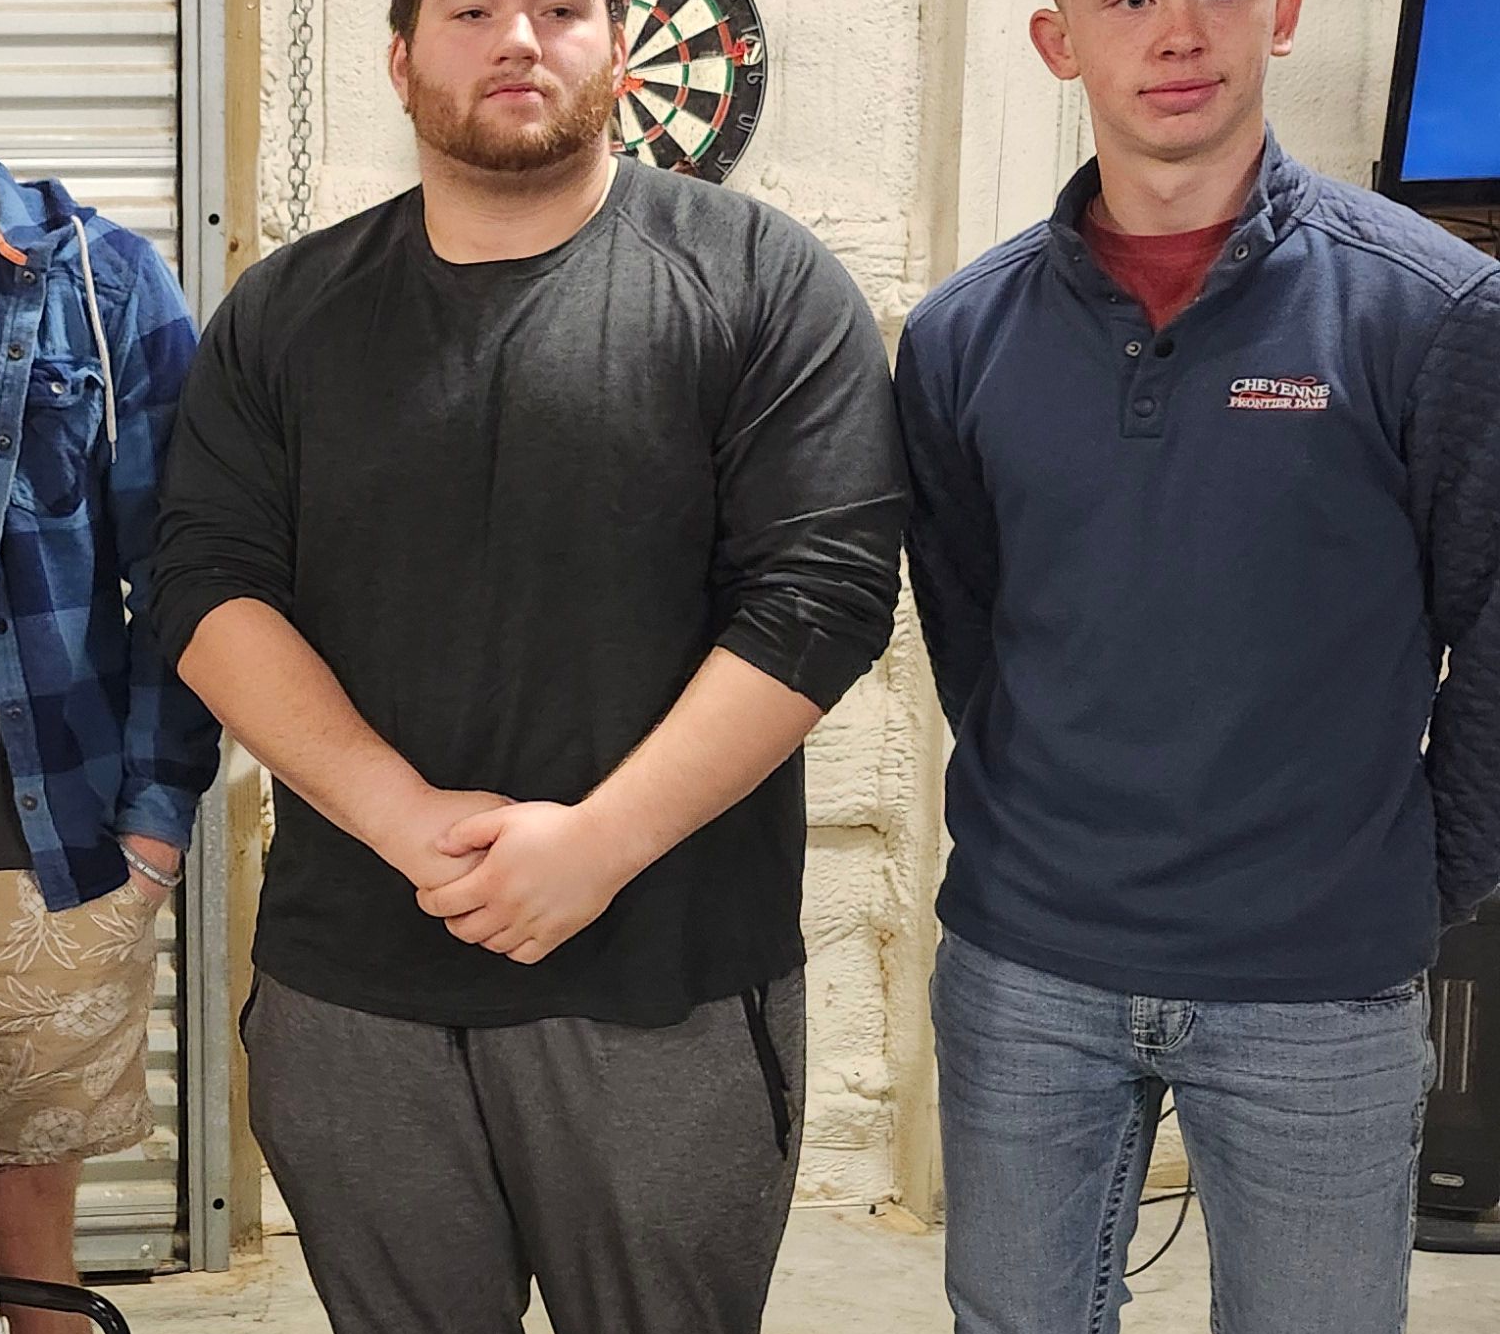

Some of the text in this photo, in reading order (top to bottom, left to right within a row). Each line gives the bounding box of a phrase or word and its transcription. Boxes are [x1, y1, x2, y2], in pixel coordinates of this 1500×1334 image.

[736, 113, 757, 133] 10
[1230, 378, 1331, 398] CHEYENNE
[1227, 396, 1329, 410] FRONTIER DAYS
